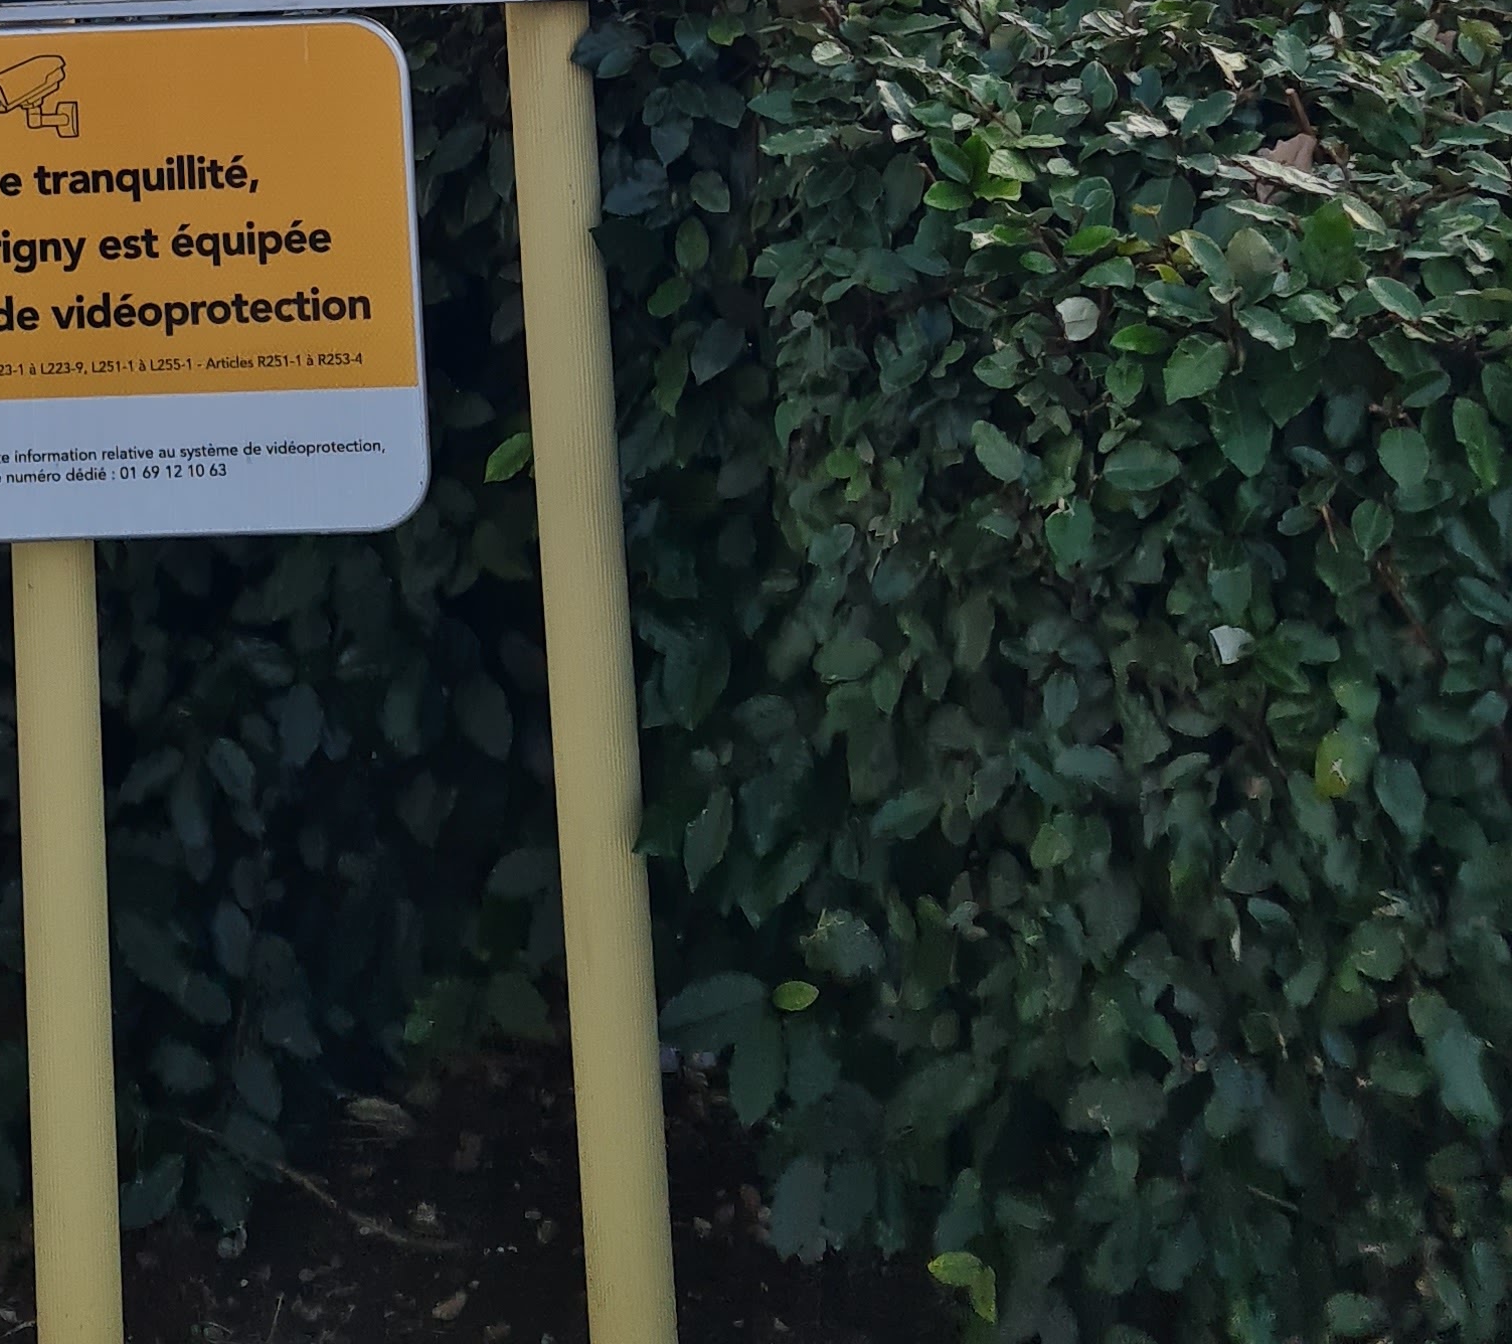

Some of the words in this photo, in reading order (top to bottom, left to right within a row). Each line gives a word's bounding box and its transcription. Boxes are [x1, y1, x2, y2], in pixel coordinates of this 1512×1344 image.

[34, 155, 258, 198] tranquillité,
[99, 229, 159, 260] est
[172, 220, 331, 266] équipée
[51, 287, 371, 336] vidéoprotection
[29, 362, 37, 376] à
[40, 361, 88, 375] L223-9,
[91, 359, 134, 374] L251-1
[138, 358, 147, 372] à
[150, 357, 192, 372] L255-1
[205, 355, 254, 370] Articles
[257, 354, 301, 368] R251-1
[306, 353, 314, 367] à
[317, 352, 363, 366] R253-4
[14, 447, 97, 463] information
[101, 445, 154, 461] relative
[158, 448, 176, 459] au
[179, 443, 239, 462] système
[242, 441, 262, 456] de
[265, 439, 386, 457] vidéoprotection,
[6, 468, 61, 484] numéro
[65, 466, 107, 482] dédié
[119, 466, 136, 480] 01
[142, 465, 160, 479] 69
[165, 464, 183, 479] 12
[187, 463, 205, 478] 10
[209, 463, 227, 477] 63
